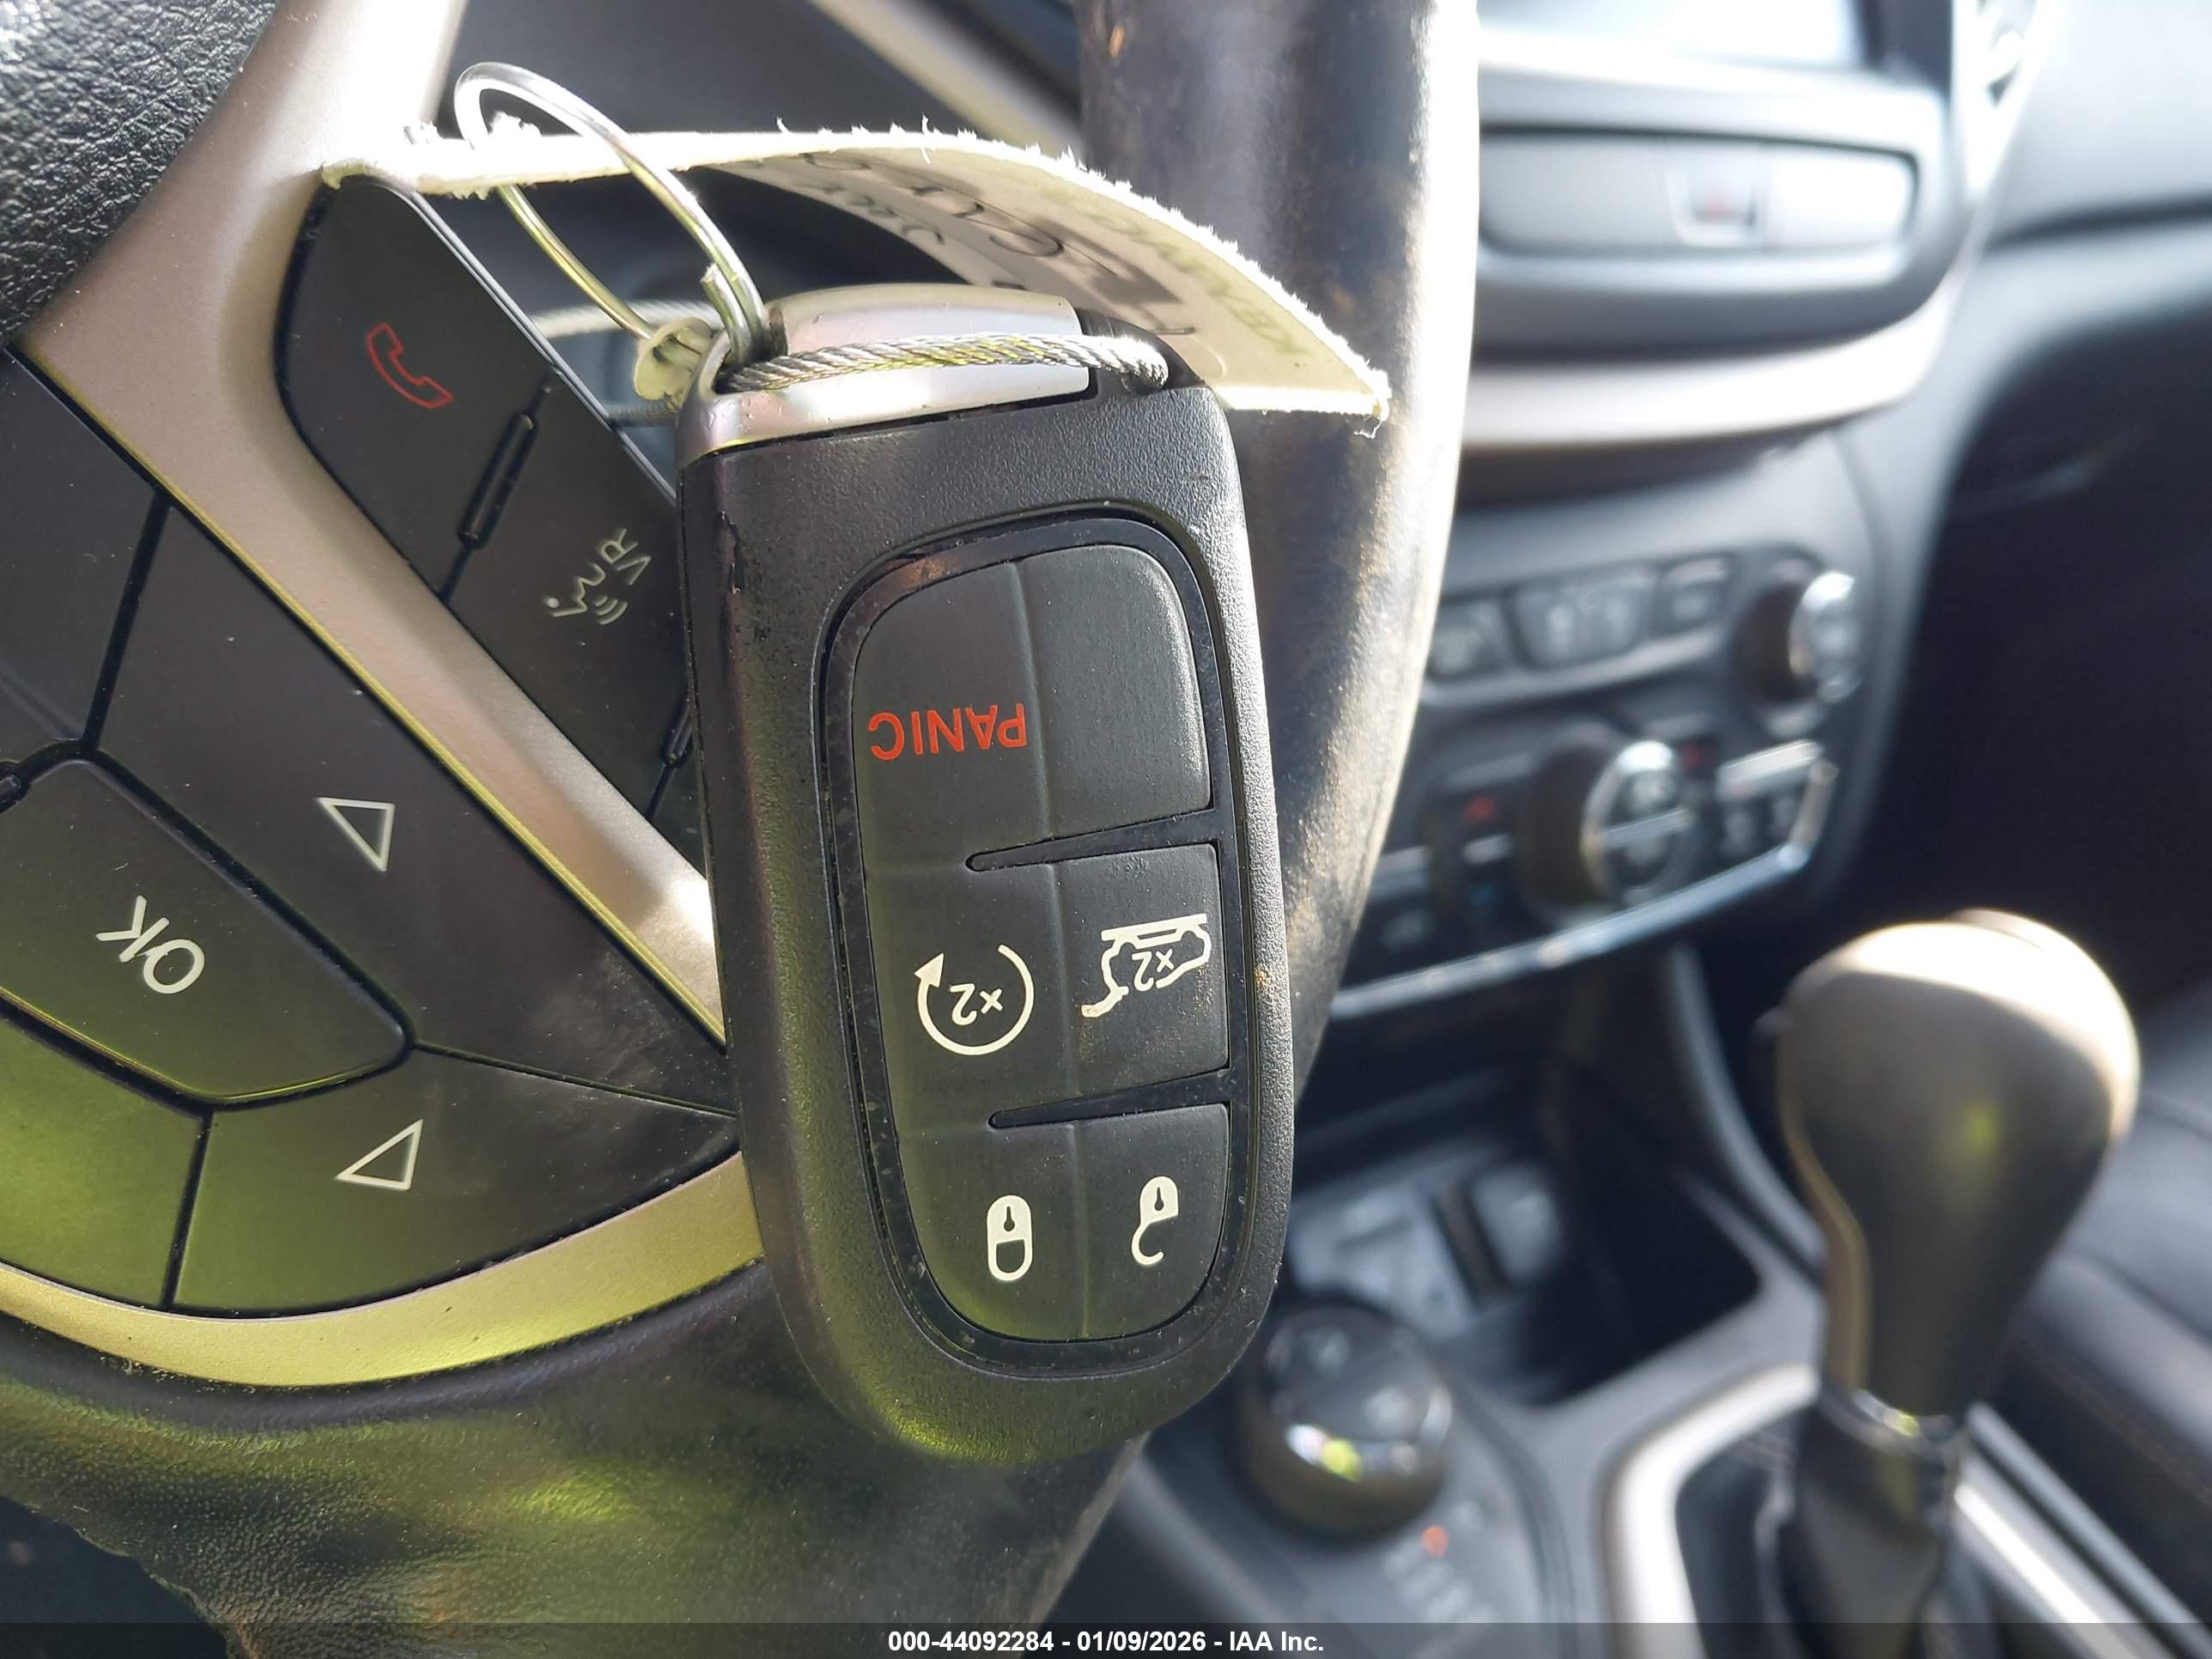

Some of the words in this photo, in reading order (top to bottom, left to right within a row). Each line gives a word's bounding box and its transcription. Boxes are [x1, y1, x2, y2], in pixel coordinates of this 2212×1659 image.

[600, 527, 653, 586] VR
[867, 702, 1028, 761] PANIC
[95, 894, 206, 994] OK
